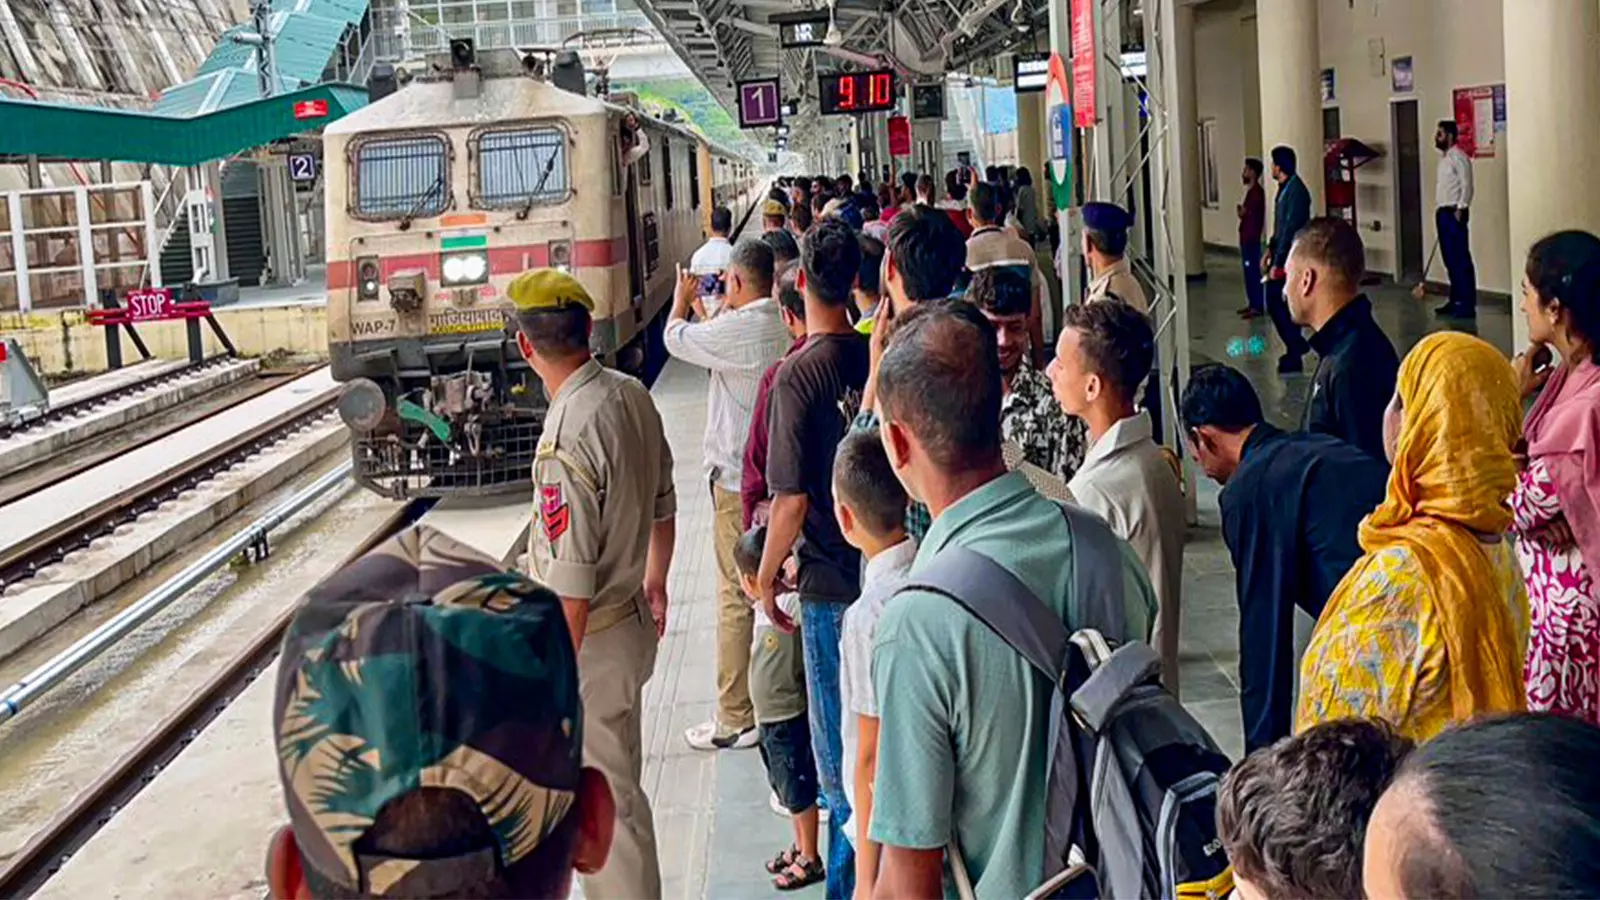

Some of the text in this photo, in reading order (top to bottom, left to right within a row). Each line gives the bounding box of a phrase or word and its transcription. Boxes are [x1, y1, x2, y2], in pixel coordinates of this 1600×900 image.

[751, 87, 764, 117] 1
[295, 157, 309, 177] 2
[131, 293, 165, 316] STOP
[350, 319, 396, 334] WAP-7
